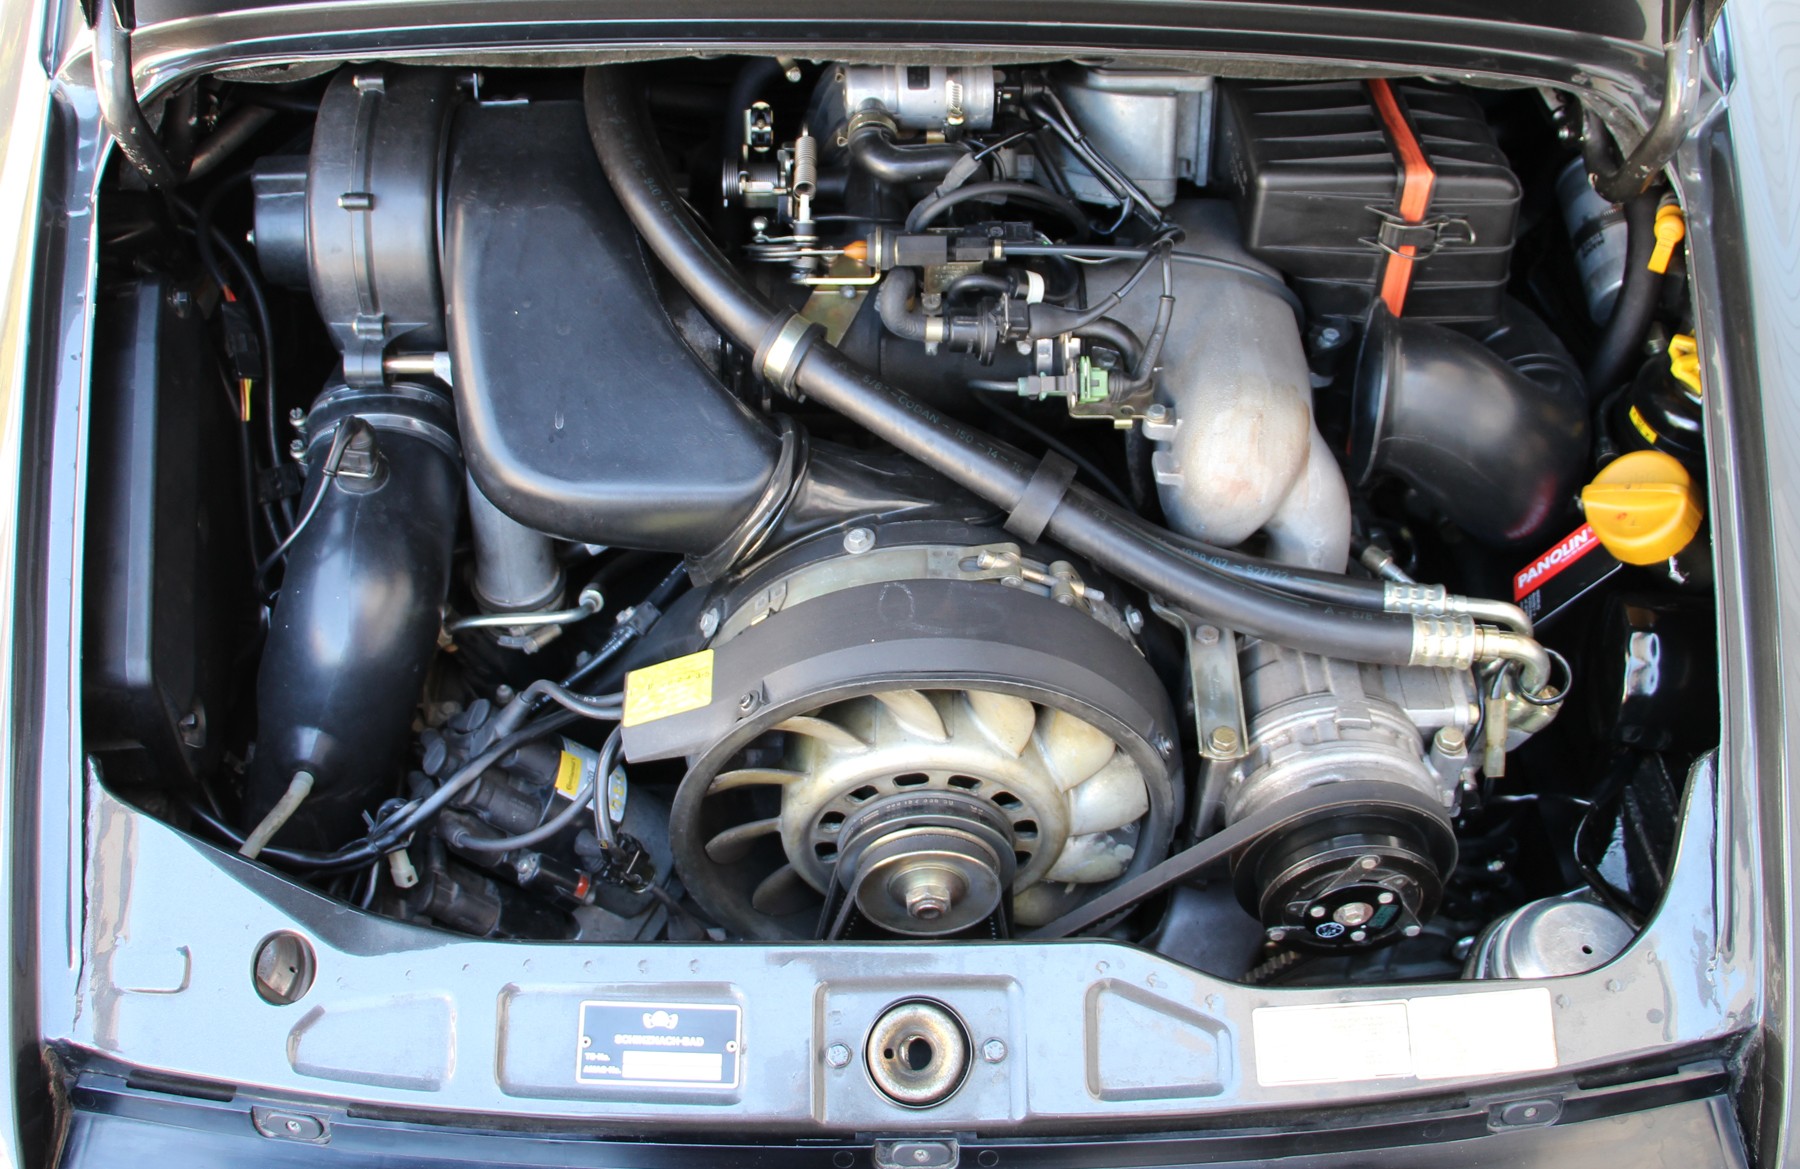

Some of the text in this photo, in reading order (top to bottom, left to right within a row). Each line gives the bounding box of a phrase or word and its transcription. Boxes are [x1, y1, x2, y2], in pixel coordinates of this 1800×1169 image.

[898, 395, 939, 424] CODAN
[954, 428, 975, 443] 150
[1517, 528, 1589, 588] PANOLIN
